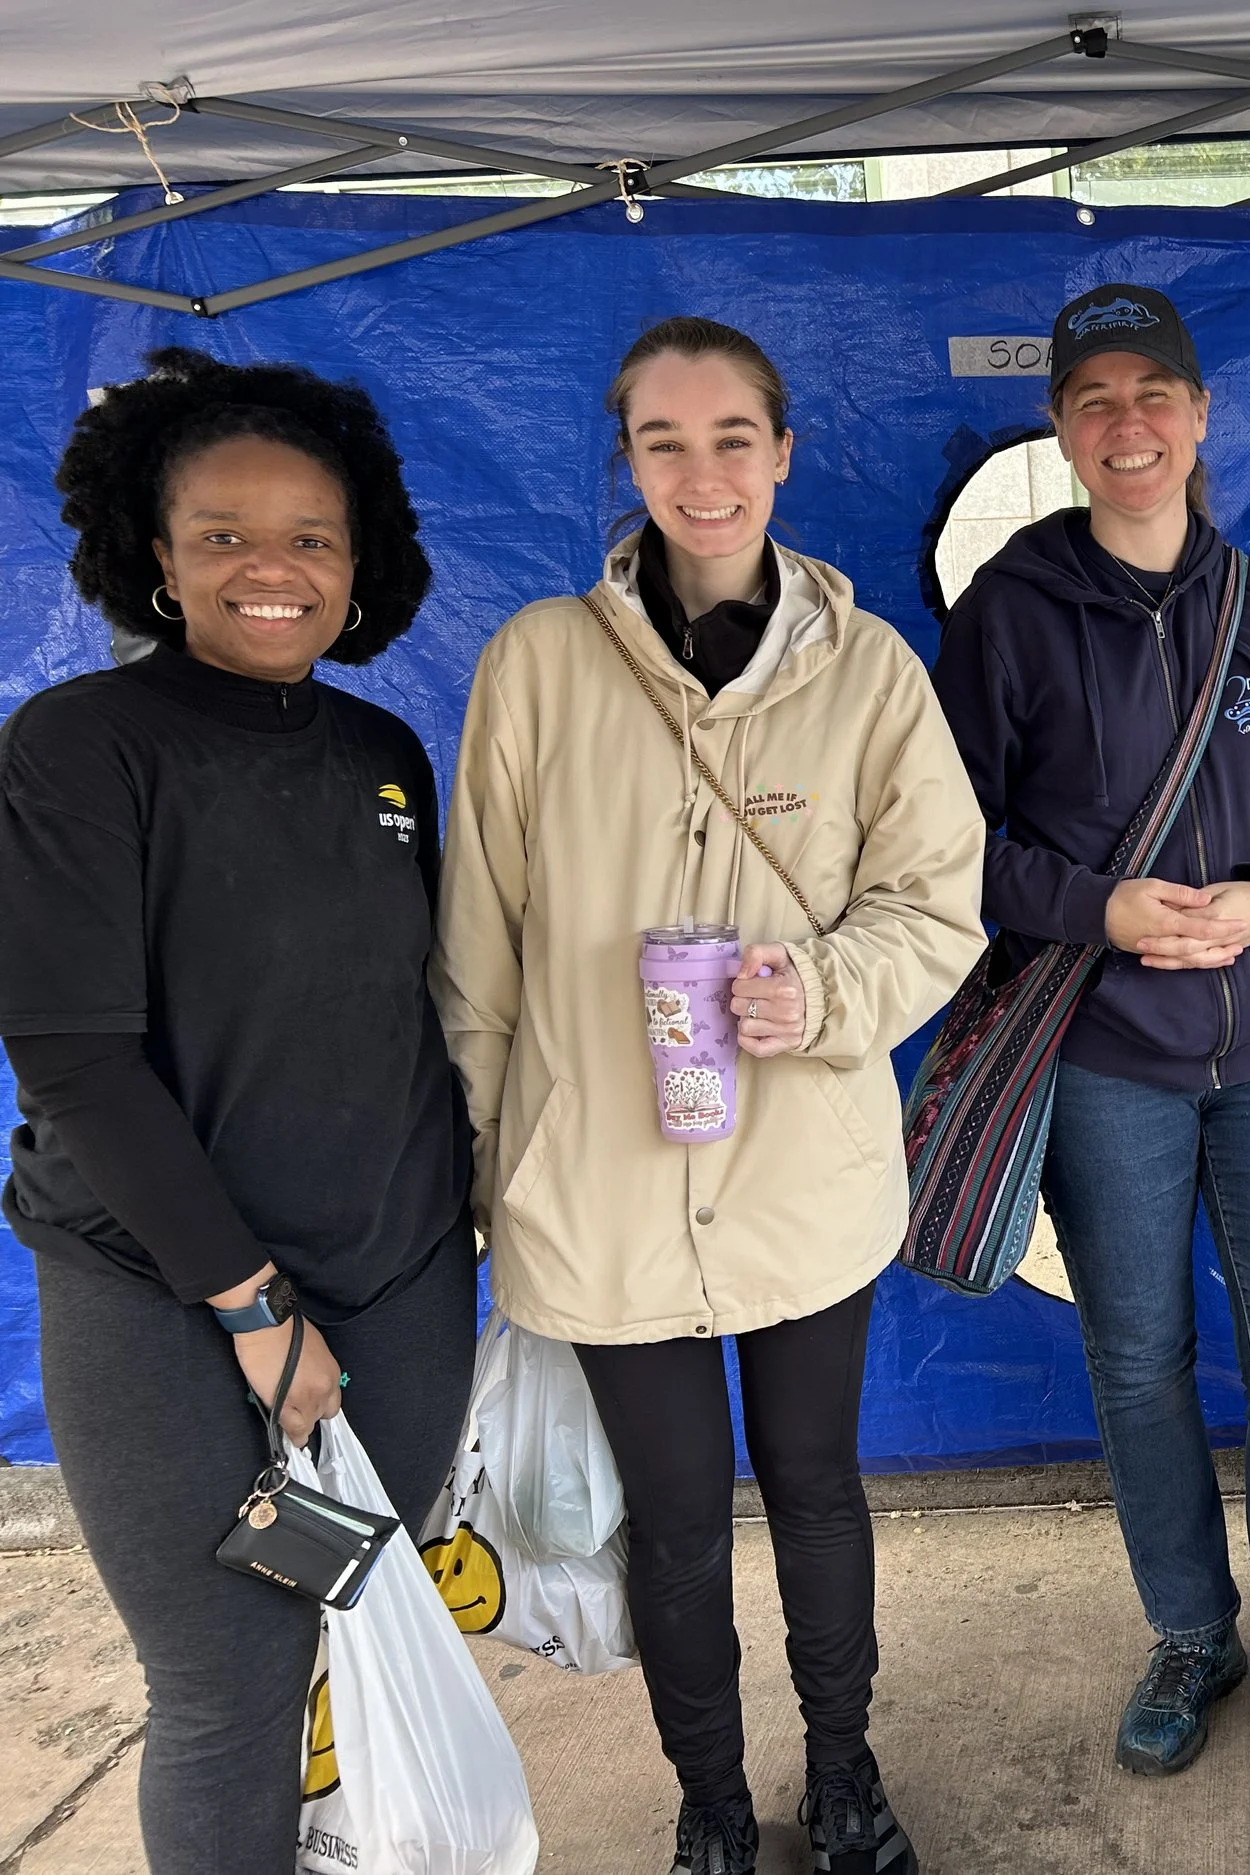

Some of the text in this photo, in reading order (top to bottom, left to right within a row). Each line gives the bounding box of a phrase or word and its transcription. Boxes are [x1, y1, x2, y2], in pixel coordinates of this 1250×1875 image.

[745, 793, 797, 807] ALL ME IF
[757, 806, 778, 815] GET
[780, 799, 807, 813] LOST
[250, 1561, 298, 1588] ANNE KLEIN
